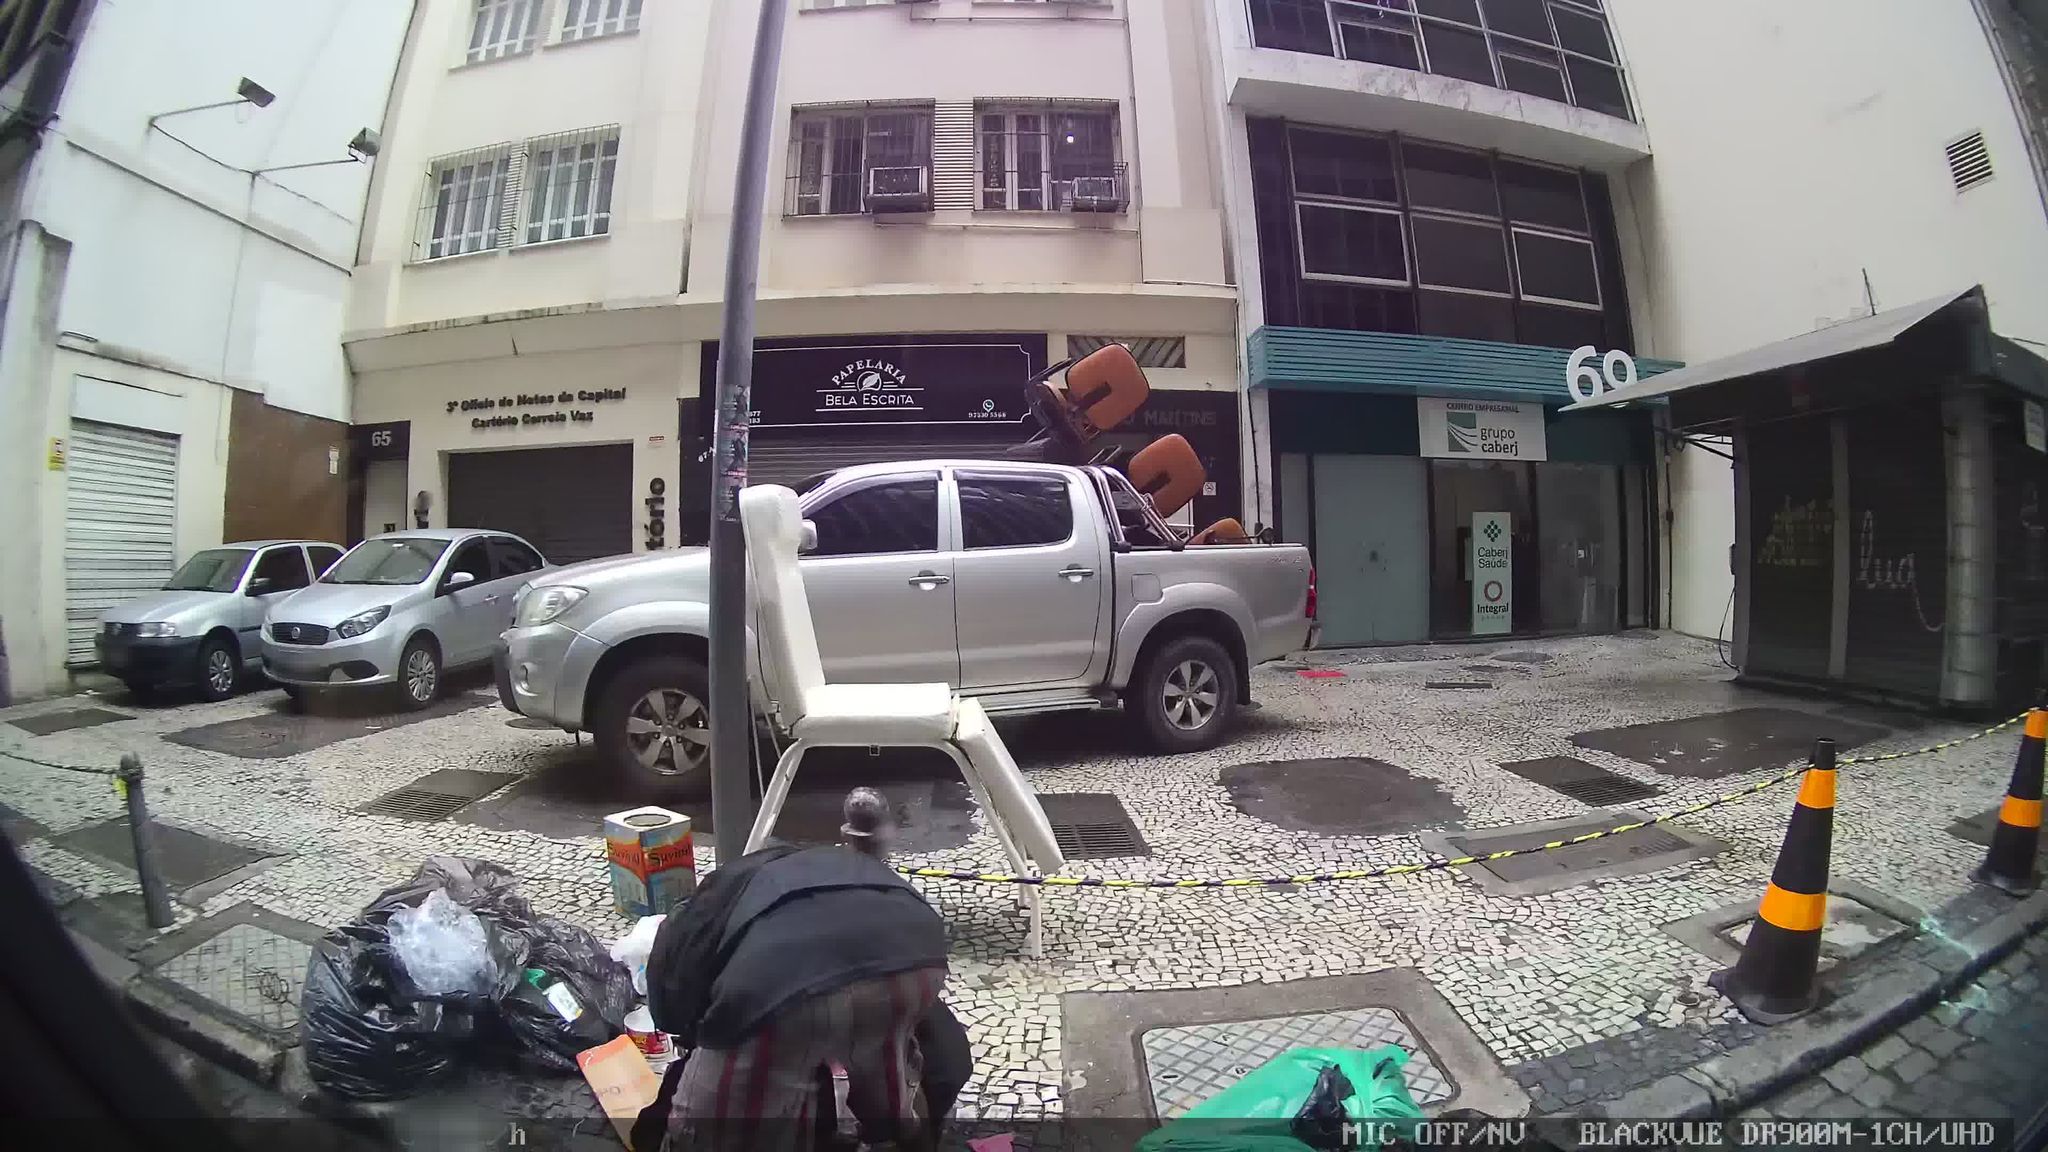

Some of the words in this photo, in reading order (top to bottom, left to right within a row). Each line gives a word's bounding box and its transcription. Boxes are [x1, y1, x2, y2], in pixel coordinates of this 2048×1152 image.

[832, 359, 906, 386] PAPELARIA
[1565, 345, 1638, 403] 69
[578, 387, 627, 403] Capital
[825, 394, 858, 406] BELA
[862, 393, 914, 405] ESCRITA
[570, 410, 594, 422] Vaz
[372, 431, 392, 447] 65
[1480, 428, 1515, 441] grupo
[1481, 441, 1518, 456] caberj
[1478, 547, 1508, 559] Caberj
[1477, 603, 1509, 614] Integral
